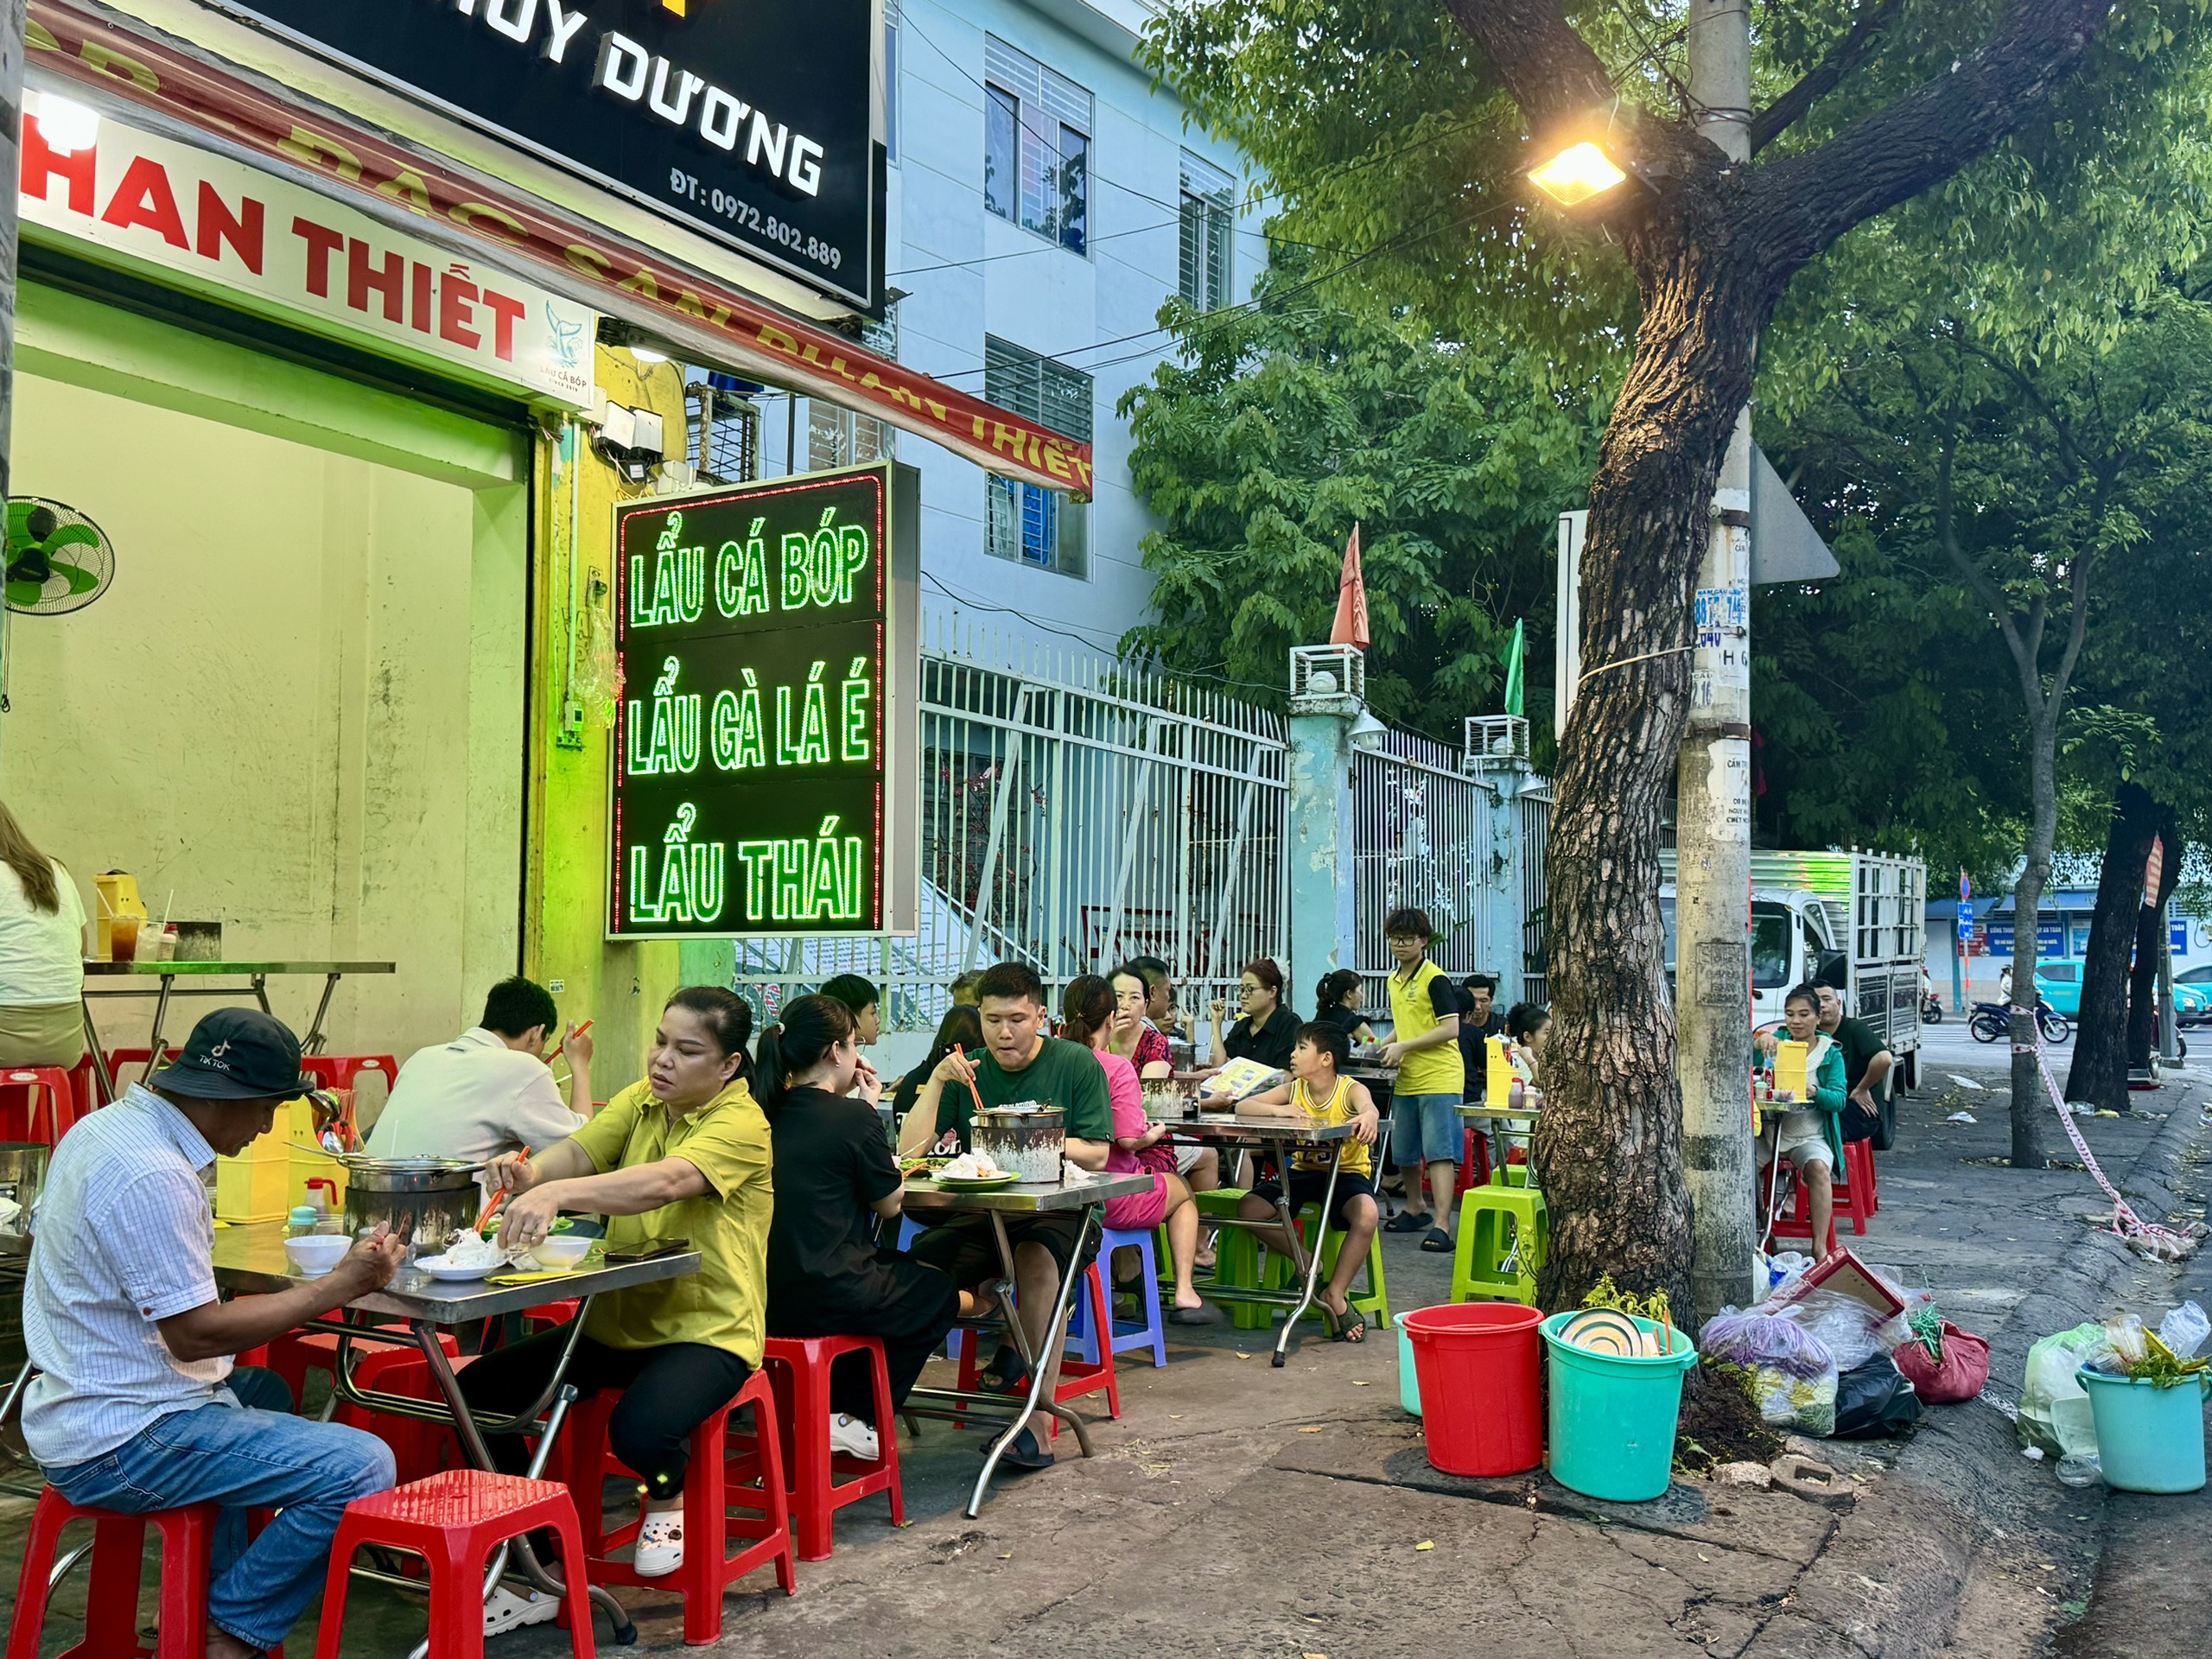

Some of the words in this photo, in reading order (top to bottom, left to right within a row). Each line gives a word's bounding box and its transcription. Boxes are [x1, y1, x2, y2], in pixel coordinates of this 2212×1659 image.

[602, 31, 824, 197] DƯƠNG
[292, 216, 525, 363] THIẾT
[711, 188, 842, 270] 0972.802.889
[570, 376, 587, 387] BÓP
[630, 510, 705, 628] LẨU
[715, 517, 770, 619] CÁ
[781, 506, 868, 610] BÓP
[627, 655, 701, 776] LẨU
[711, 667, 766, 770] GÀ
[777, 660, 830, 766] LÁ
[842, 657, 870, 761] É
[630, 802, 724, 923] LẨU
[738, 815, 862, 920] THÁI
